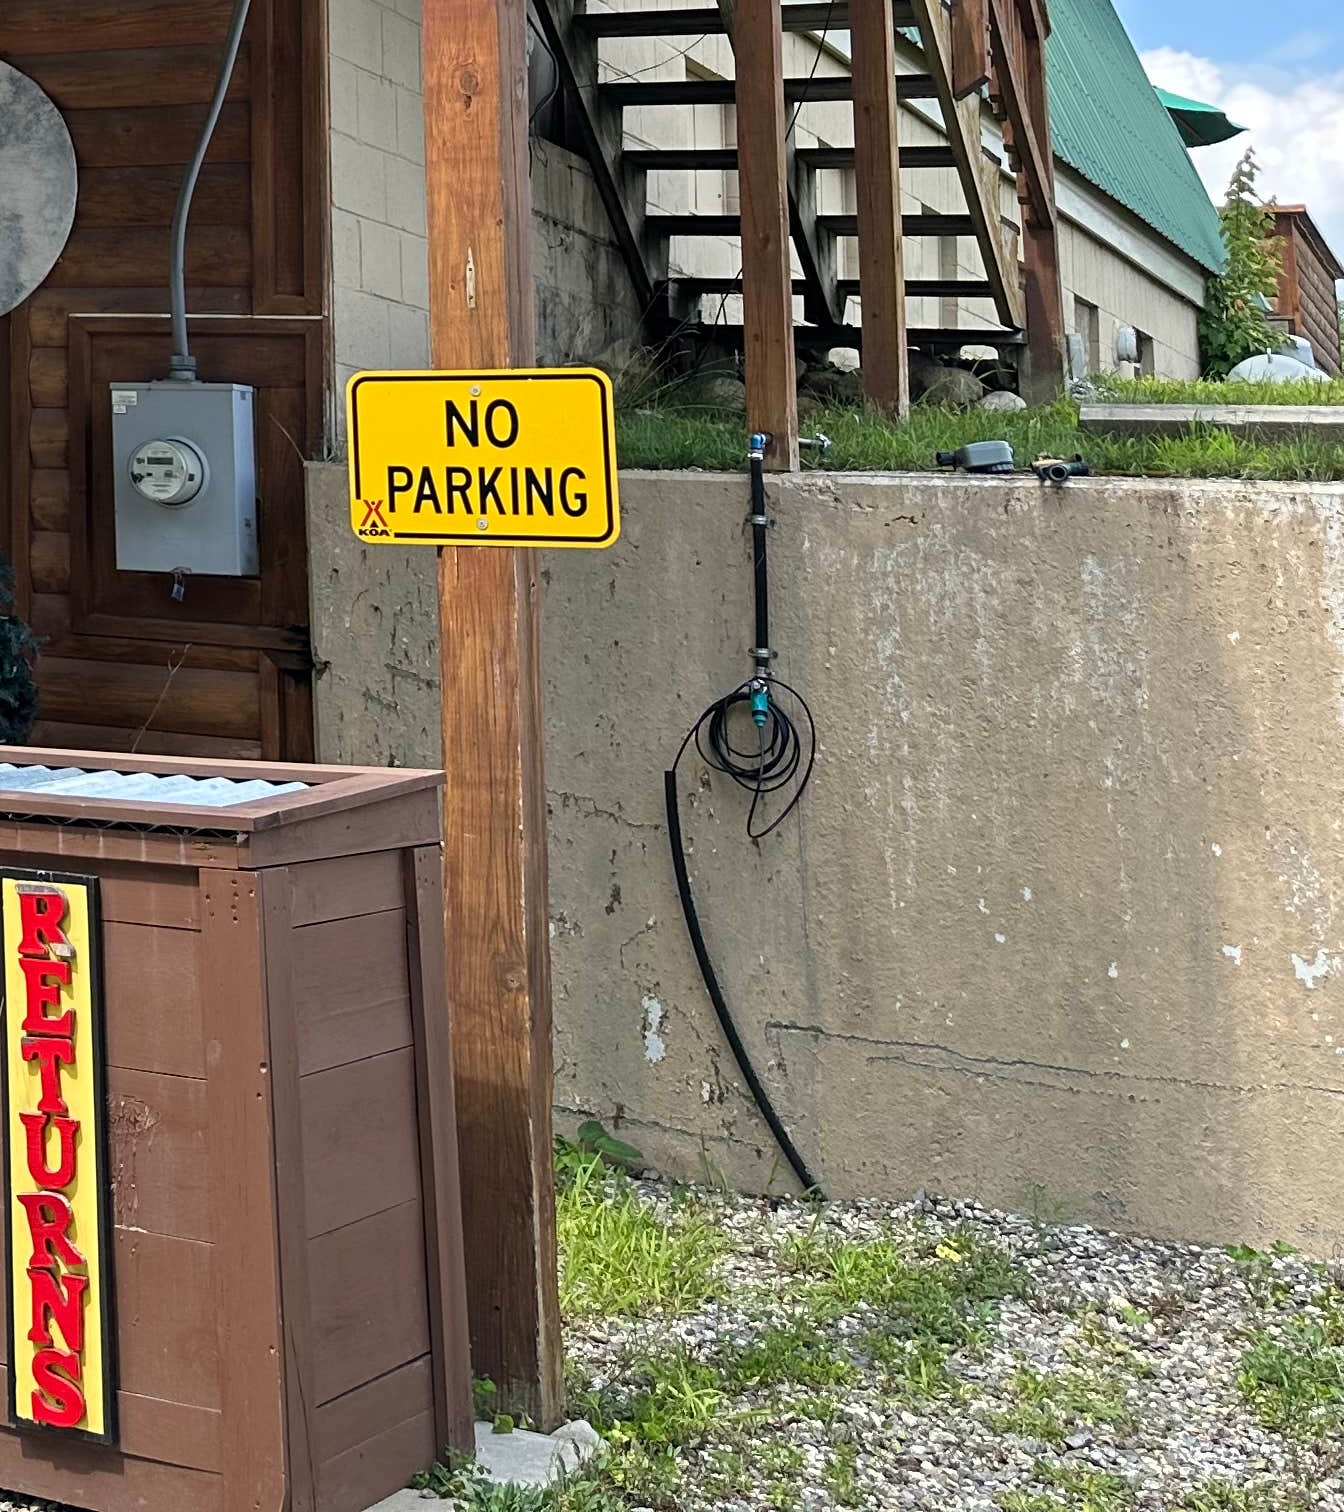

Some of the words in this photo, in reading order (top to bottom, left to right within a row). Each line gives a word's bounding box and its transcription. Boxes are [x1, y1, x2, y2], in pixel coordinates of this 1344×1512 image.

[445, 399, 519, 448] NO
[387, 466, 587, 517] PARKING
[358, 528, 391, 536] KOA
[15, 883, 88, 1428] RETURNS
